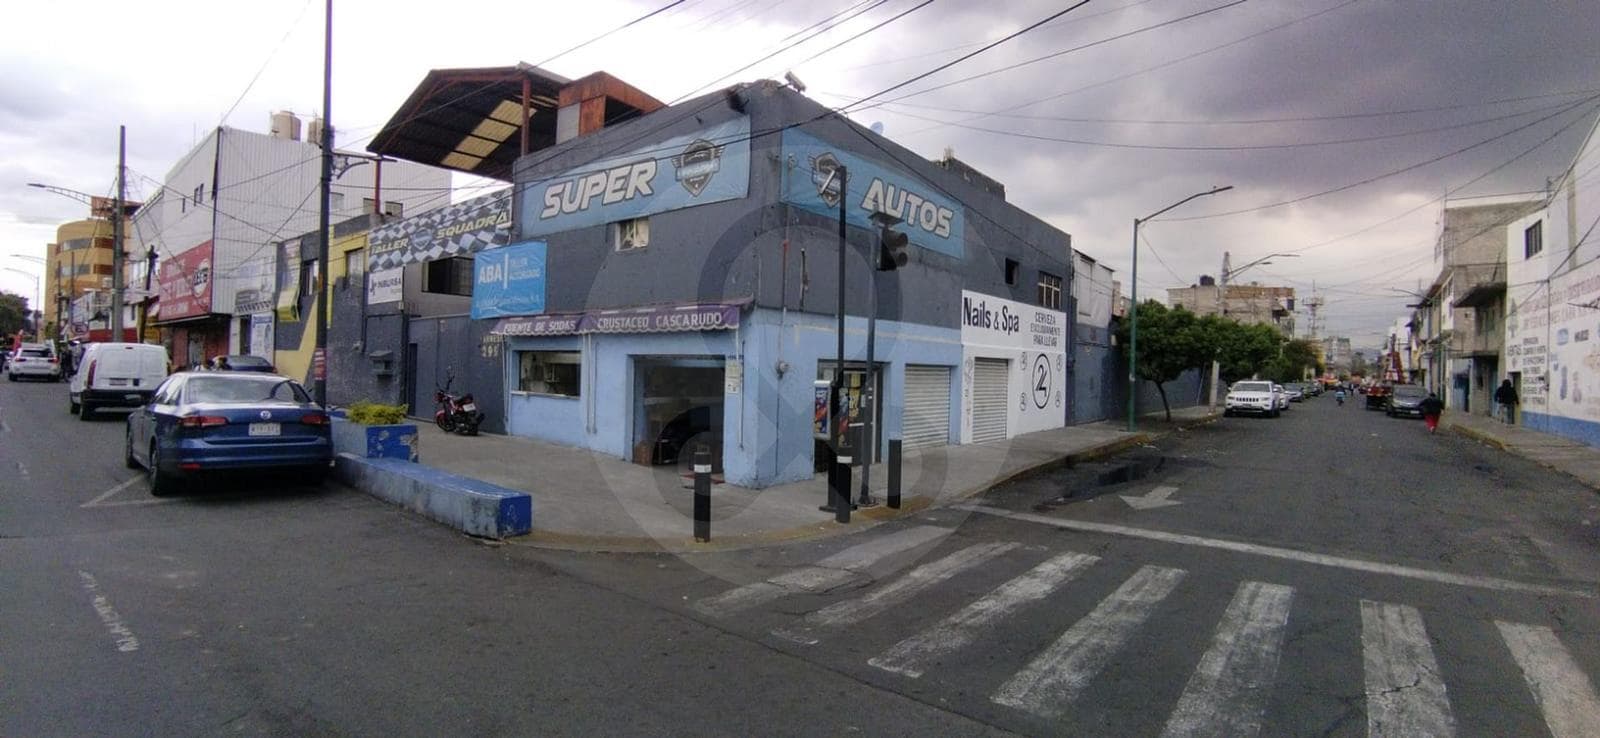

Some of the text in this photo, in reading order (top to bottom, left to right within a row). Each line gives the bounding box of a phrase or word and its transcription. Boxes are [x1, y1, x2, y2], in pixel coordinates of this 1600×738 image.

[540, 158, 657, 219] SUPER
[861, 177, 953, 239] AUTOS
[371, 211, 508, 254] TALLER SQUADRA
[478, 263, 502, 284] ABA
[504, 321, 576, 333] FUENTE DE SODAS
[597, 312, 721, 330] CRUSTACEO CASCARUDO
[963, 297, 1019, 336] Nails & Spa
[1034, 311, 1056, 326] CERVEZA
